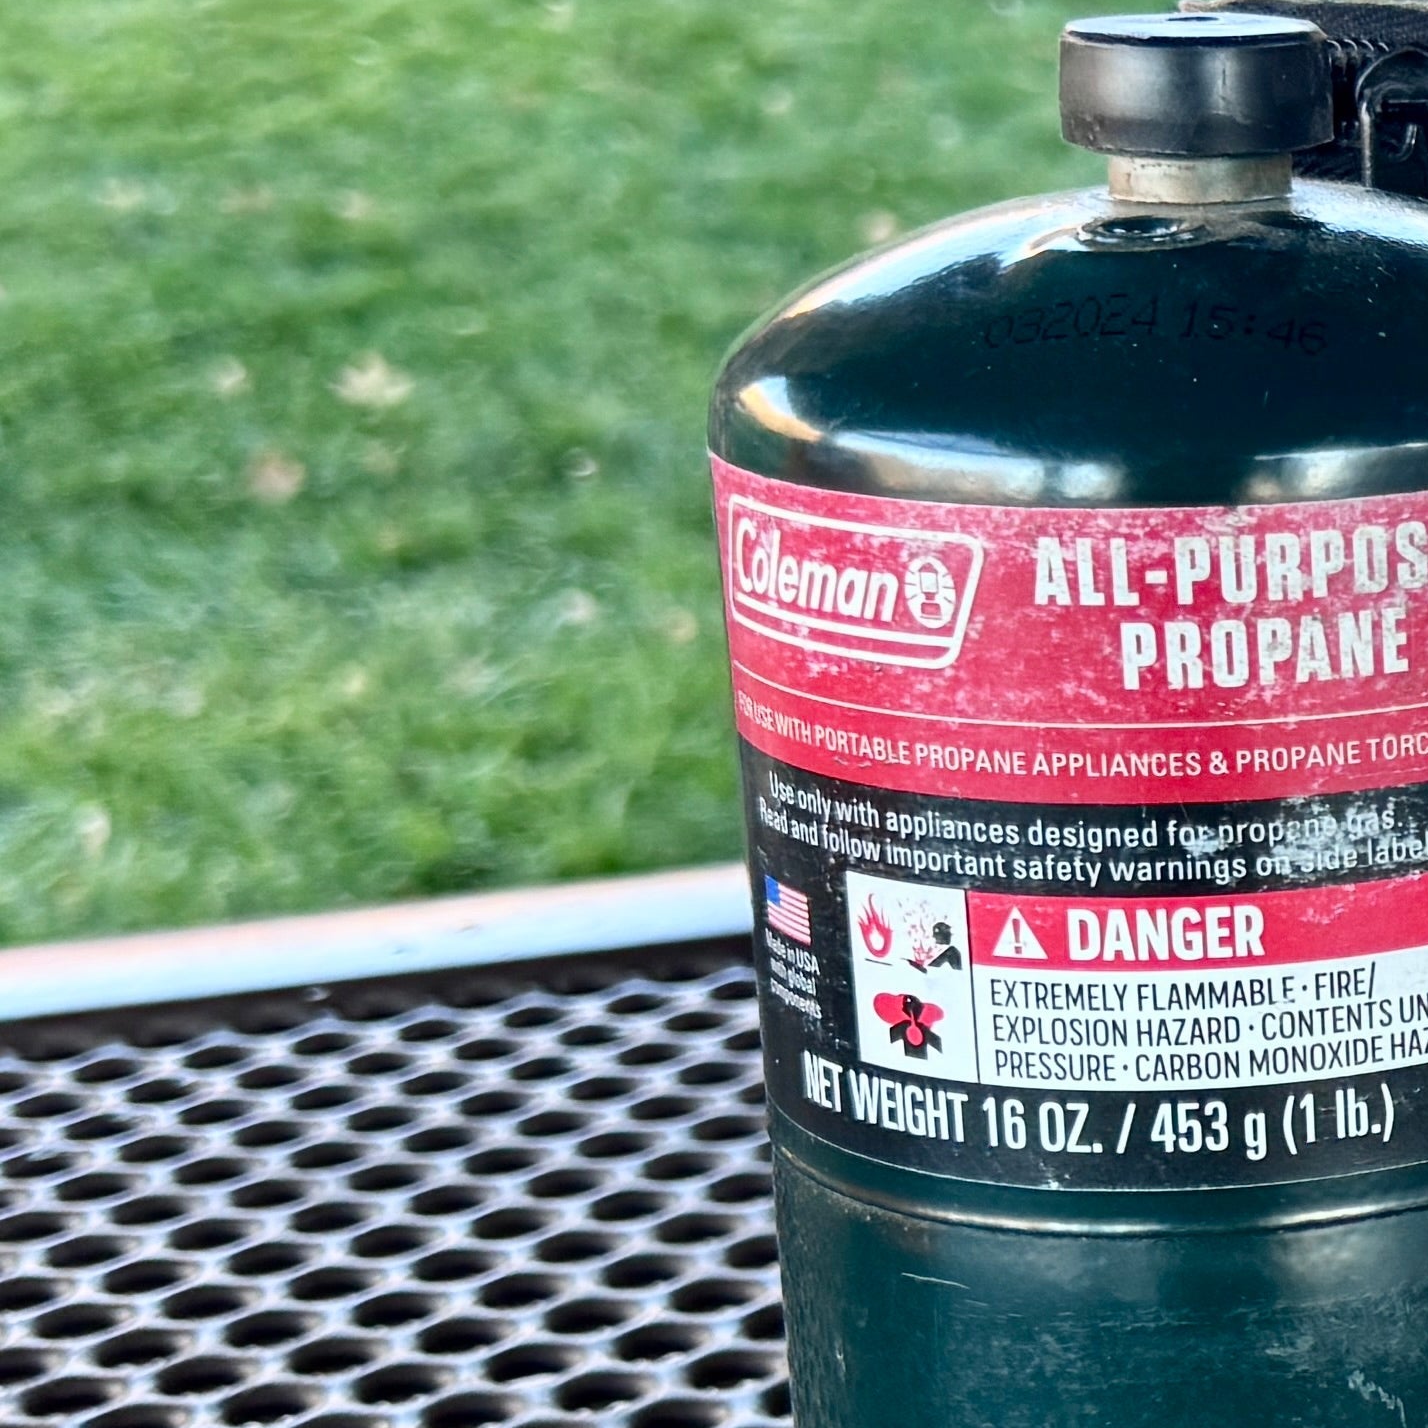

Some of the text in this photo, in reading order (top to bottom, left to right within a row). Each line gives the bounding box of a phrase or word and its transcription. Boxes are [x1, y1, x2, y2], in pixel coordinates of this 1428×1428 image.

[1178, 299, 1330, 356] 15:46
[736, 518, 898, 623] Coleman
[1120, 607, 1408, 690] PROPANE
[776, 713, 812, 742] WITH
[815, 727, 910, 765] PORTABLE
[914, 746, 1026, 775] PROPANE
[1032, 751, 1201, 777] APPLIANCES
[1210, 752, 1229, 774] &
[1236, 741, 1361, 772] PROPANE
[759, 797, 788, 832] Read
[791, 817, 819, 845] and
[822, 828, 880, 862] follow
[887, 838, 1006, 874] important
[1013, 856, 1101, 887] safety
[1110, 860, 1247, 886] warnings
[1256, 856, 1290, 875] on
[1300, 846, 1357, 873] side
[769, 772, 794, 803] Use
[799, 788, 831, 817] only
[836, 798, 879, 828] with
[886, 811, 1019, 843] appliances
[1028, 818, 1158, 852] designed
[1168, 820, 1207, 846] for
[1218, 814, 1336, 853] propane
[1067, 905, 1265, 961] DANGER
[991, 961, 1376, 1011] EXTREMELY FLAMMABLE FIRE/
[993, 1014, 1127, 1046] EXPLOSION
[1138, 1016, 1240, 1047] HAZARD
[1262, 999, 1392, 1041] CONTENTS
[996, 1050, 1116, 1082] PRESSURE
[1136, 1051, 1239, 1082] CARBON
[1250, 1035, 1384, 1077] MONOXIDE
[804, 1051, 842, 1112] NET
[848, 1071, 968, 1143] WEIGHT
[983, 1096, 1026, 1150] 16
[1039, 1101, 1102, 1153] OZ.
[1151, 1101, 1227, 1153] 453
[1244, 1111, 1267, 1160] g
[1283, 1095, 1316, 1155] (1
[1336, 1084, 1394, 1142] lb.)
